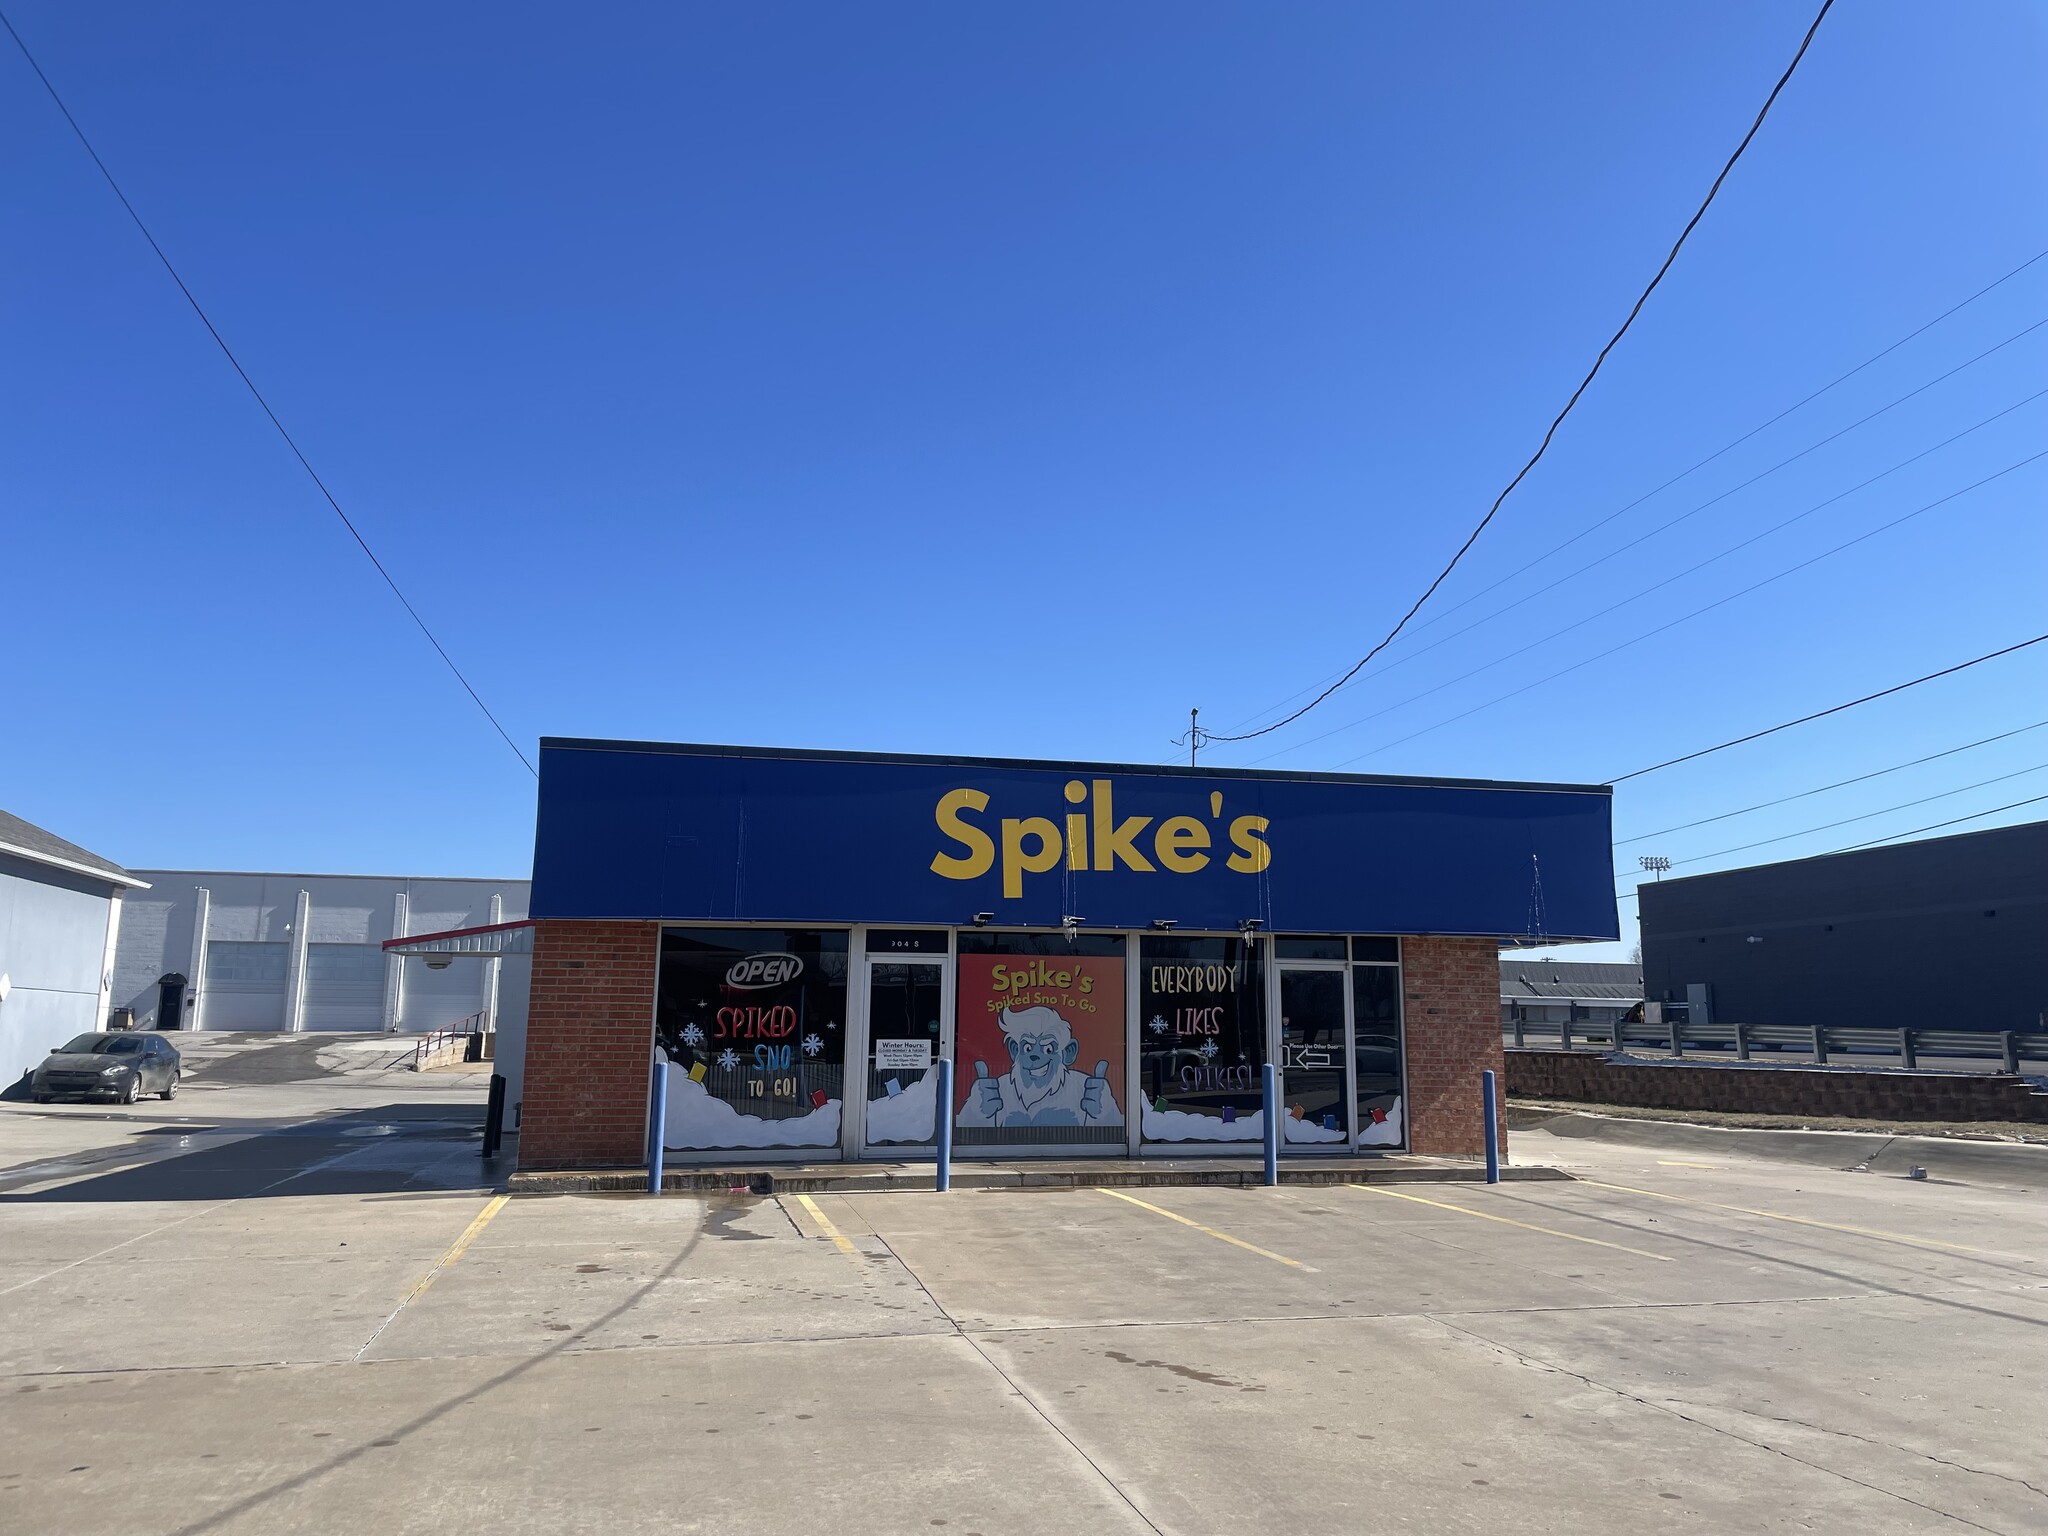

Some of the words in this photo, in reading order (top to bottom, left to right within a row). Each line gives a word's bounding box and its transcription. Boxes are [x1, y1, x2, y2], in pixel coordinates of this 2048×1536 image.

[930, 780, 1271, 898] Spike's
[914, 940, 919, 948] S
[731, 960, 796, 982] OPEN
[991, 960, 1094, 996] Spike's
[1152, 965, 1237, 993] EVERYBODY
[987, 992, 1031, 1012] Spiked
[1034, 992, 1058, 1005] Sno
[1062, 993, 1076, 1007] To
[1079, 998, 1097, 1013] Go
[714, 1006, 797, 1038] SPIKED
[1176, 1006, 1224, 1035] LIKES
[752, 1044, 791, 1071] SNO
[748, 1080, 764, 1097] TO
[774, 1077, 797, 1098] GO!
[1181, 1065, 1252, 1092] SPIKES!
